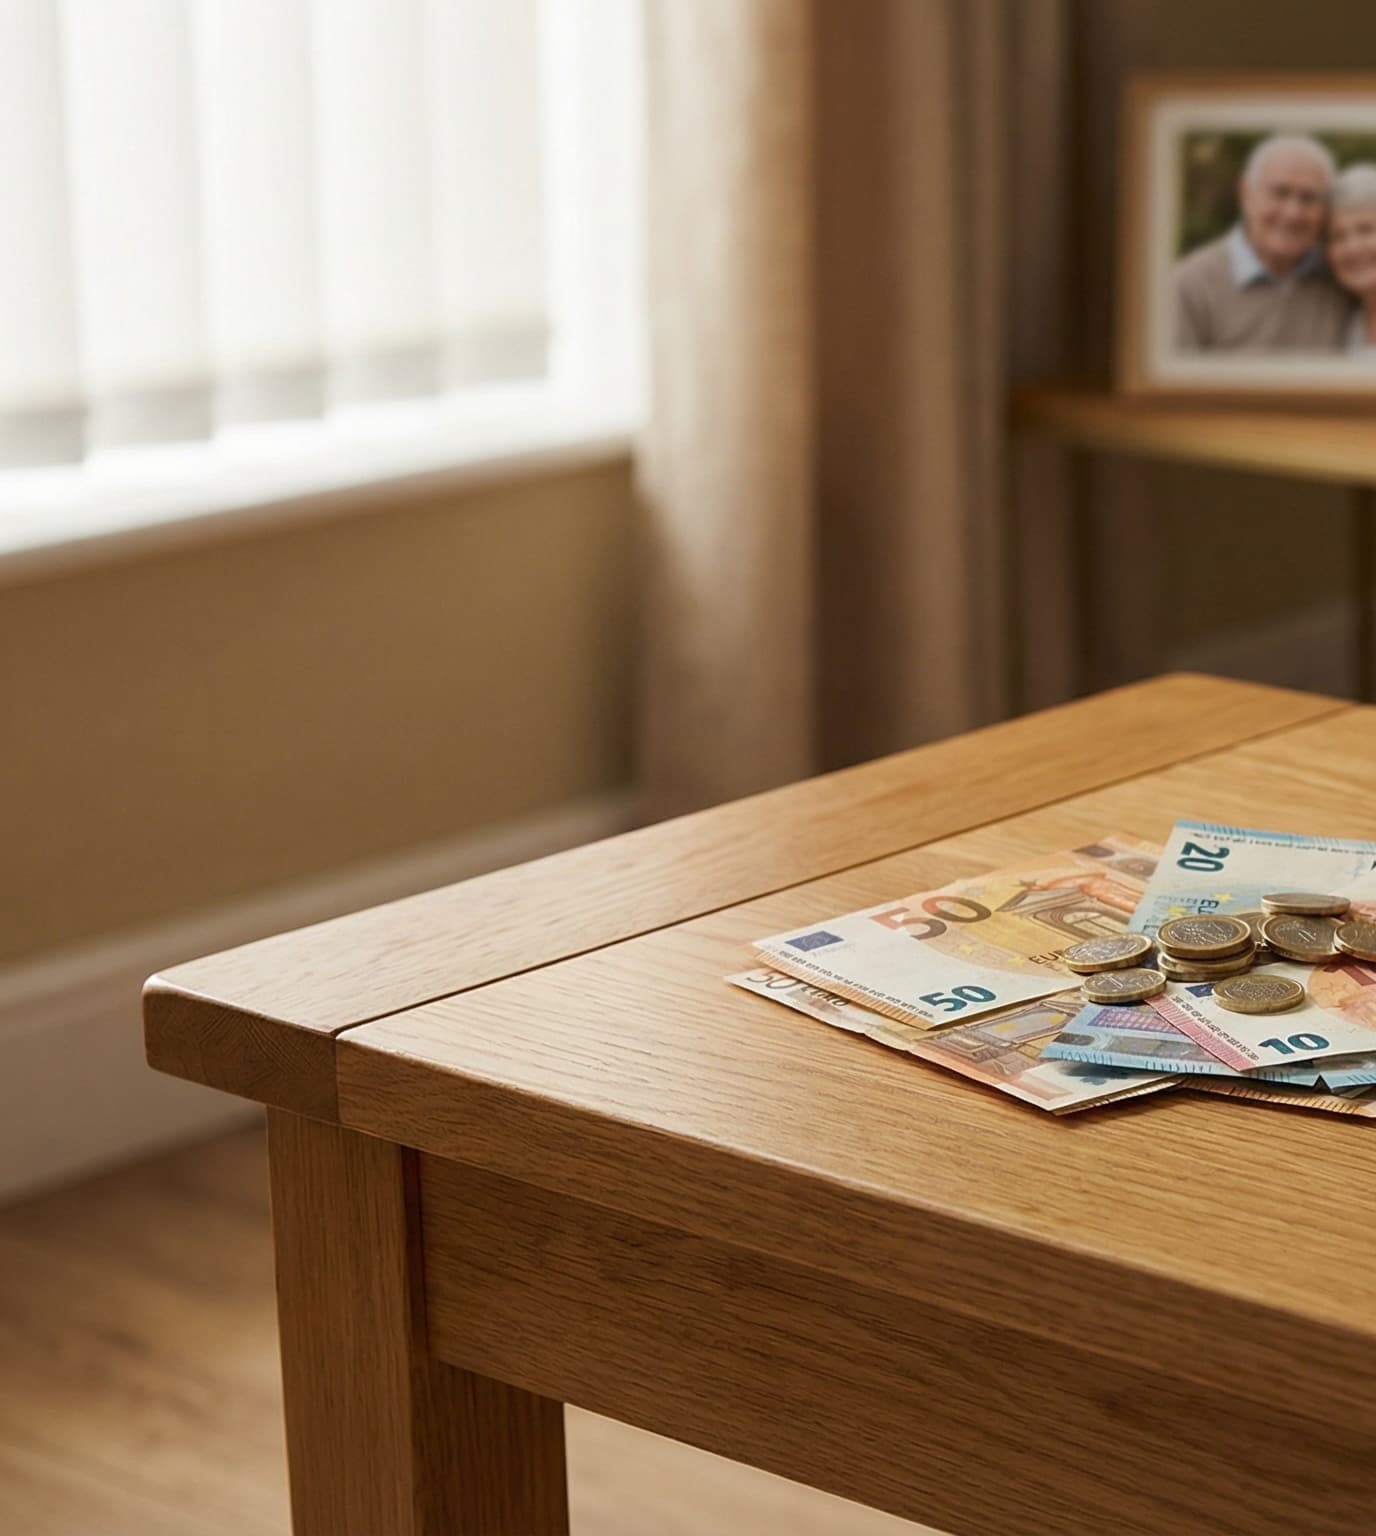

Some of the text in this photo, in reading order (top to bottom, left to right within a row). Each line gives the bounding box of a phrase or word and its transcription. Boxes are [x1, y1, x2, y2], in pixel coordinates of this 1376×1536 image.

[1176, 841, 1231, 873] 20
[870, 895, 992, 940] 50
[918, 985, 997, 1012] 50
[1258, 1033, 1329, 1055] 10
